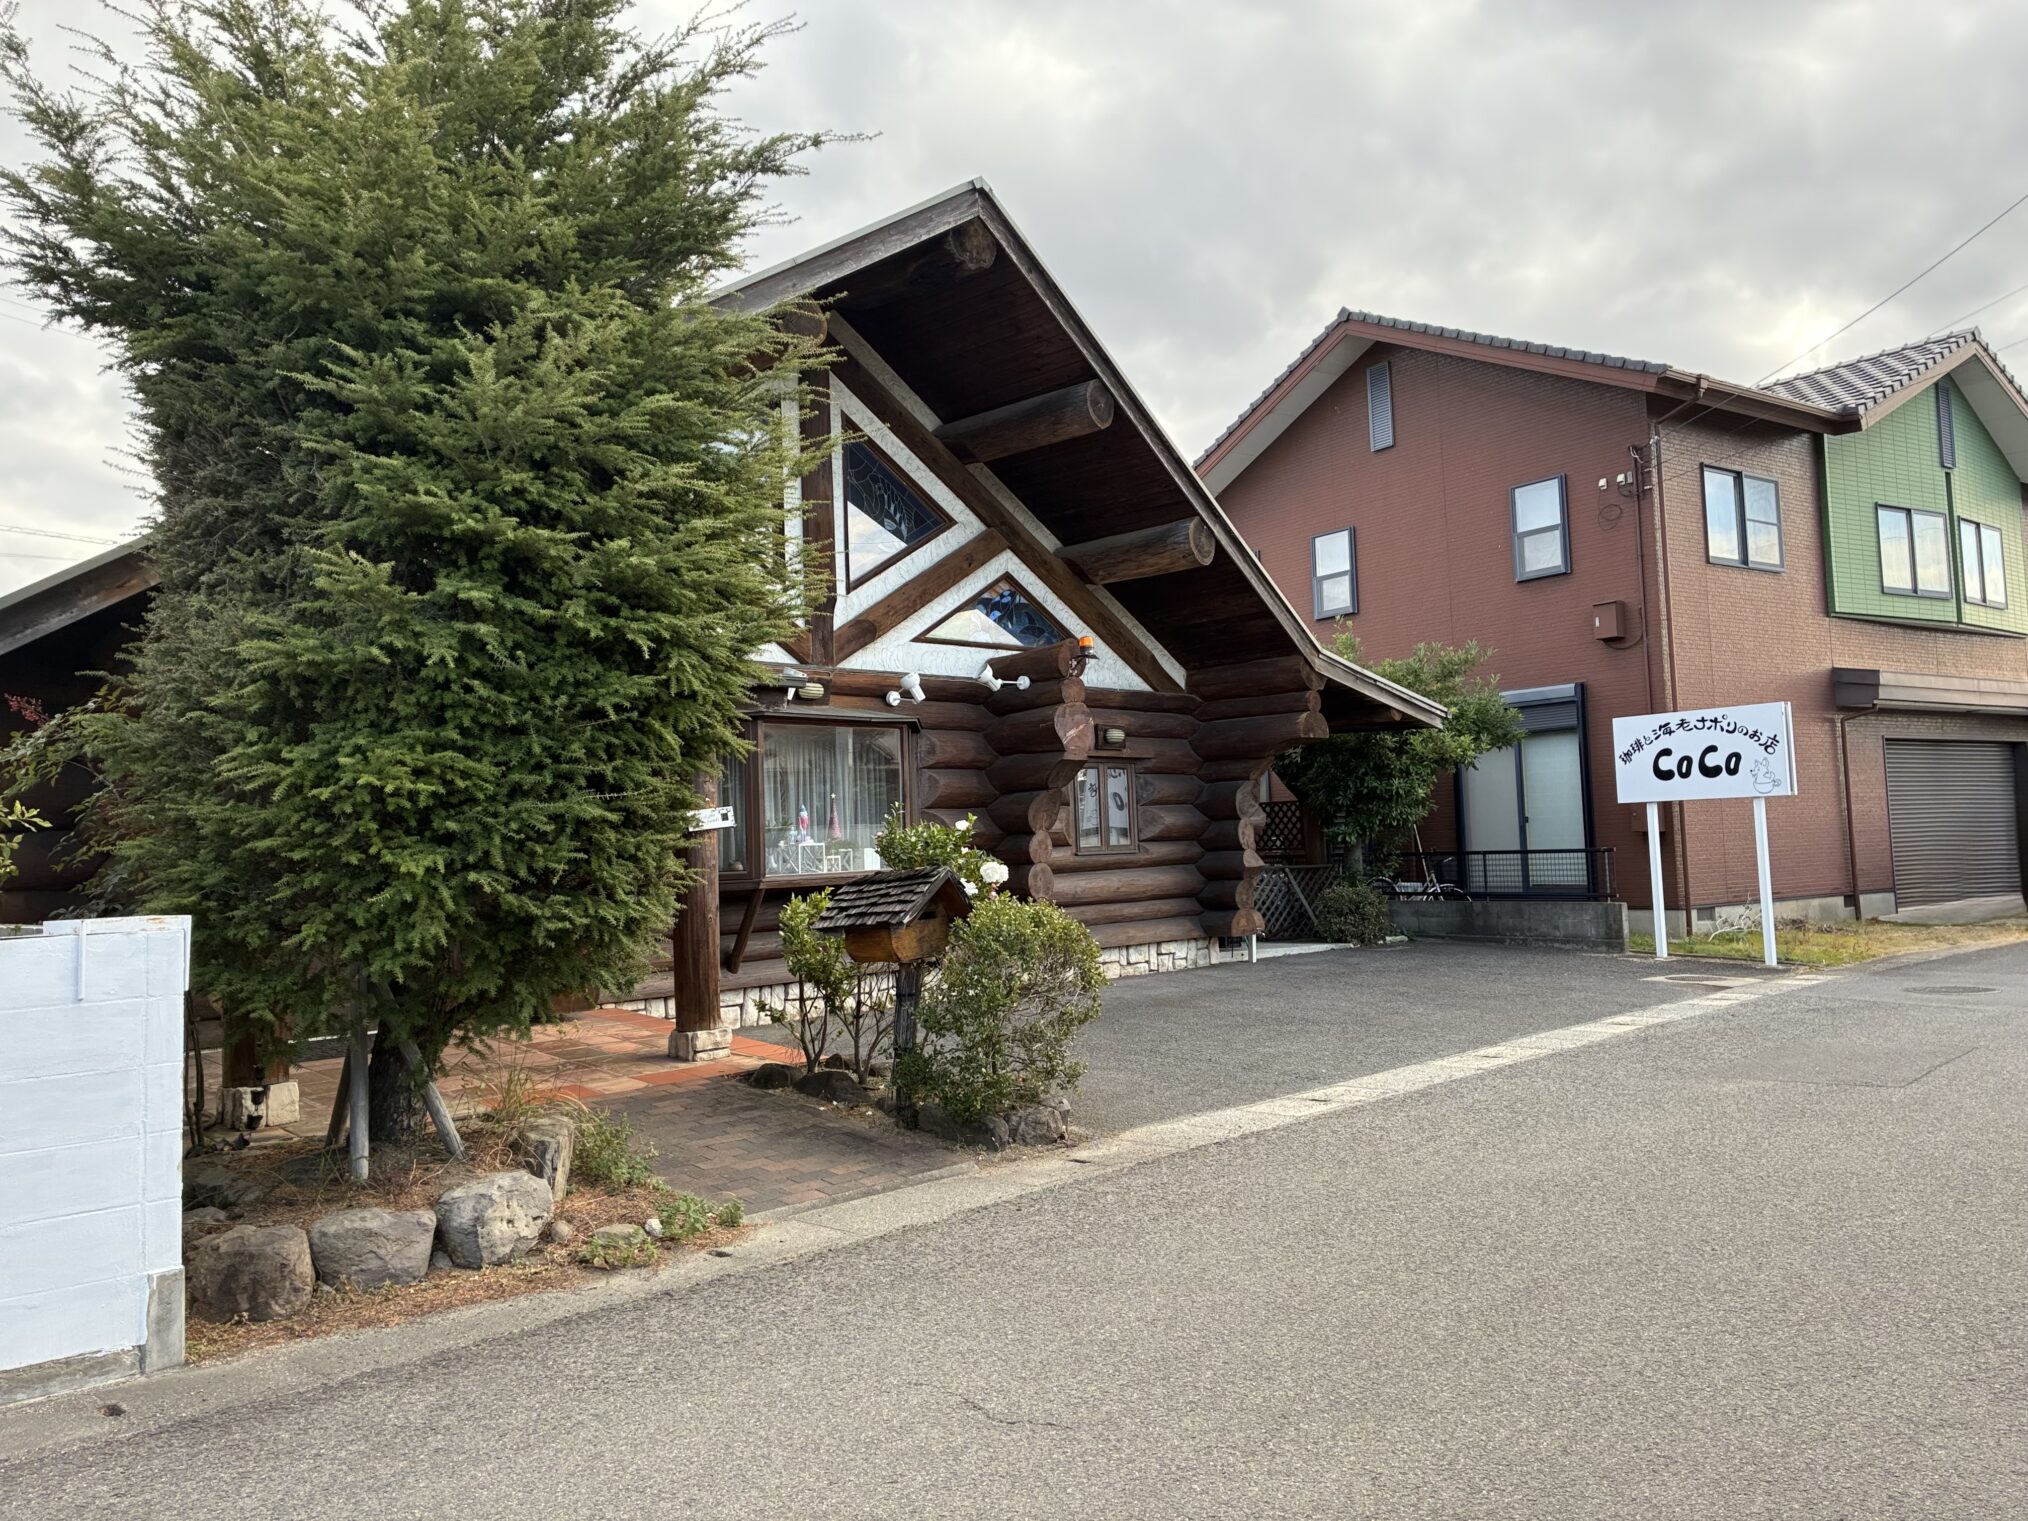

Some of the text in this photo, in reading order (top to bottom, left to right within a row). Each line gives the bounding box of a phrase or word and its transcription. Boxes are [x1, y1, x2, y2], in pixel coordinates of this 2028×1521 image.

[1618, 713, 1780, 766] 珈琲と海老ナポリのお店
